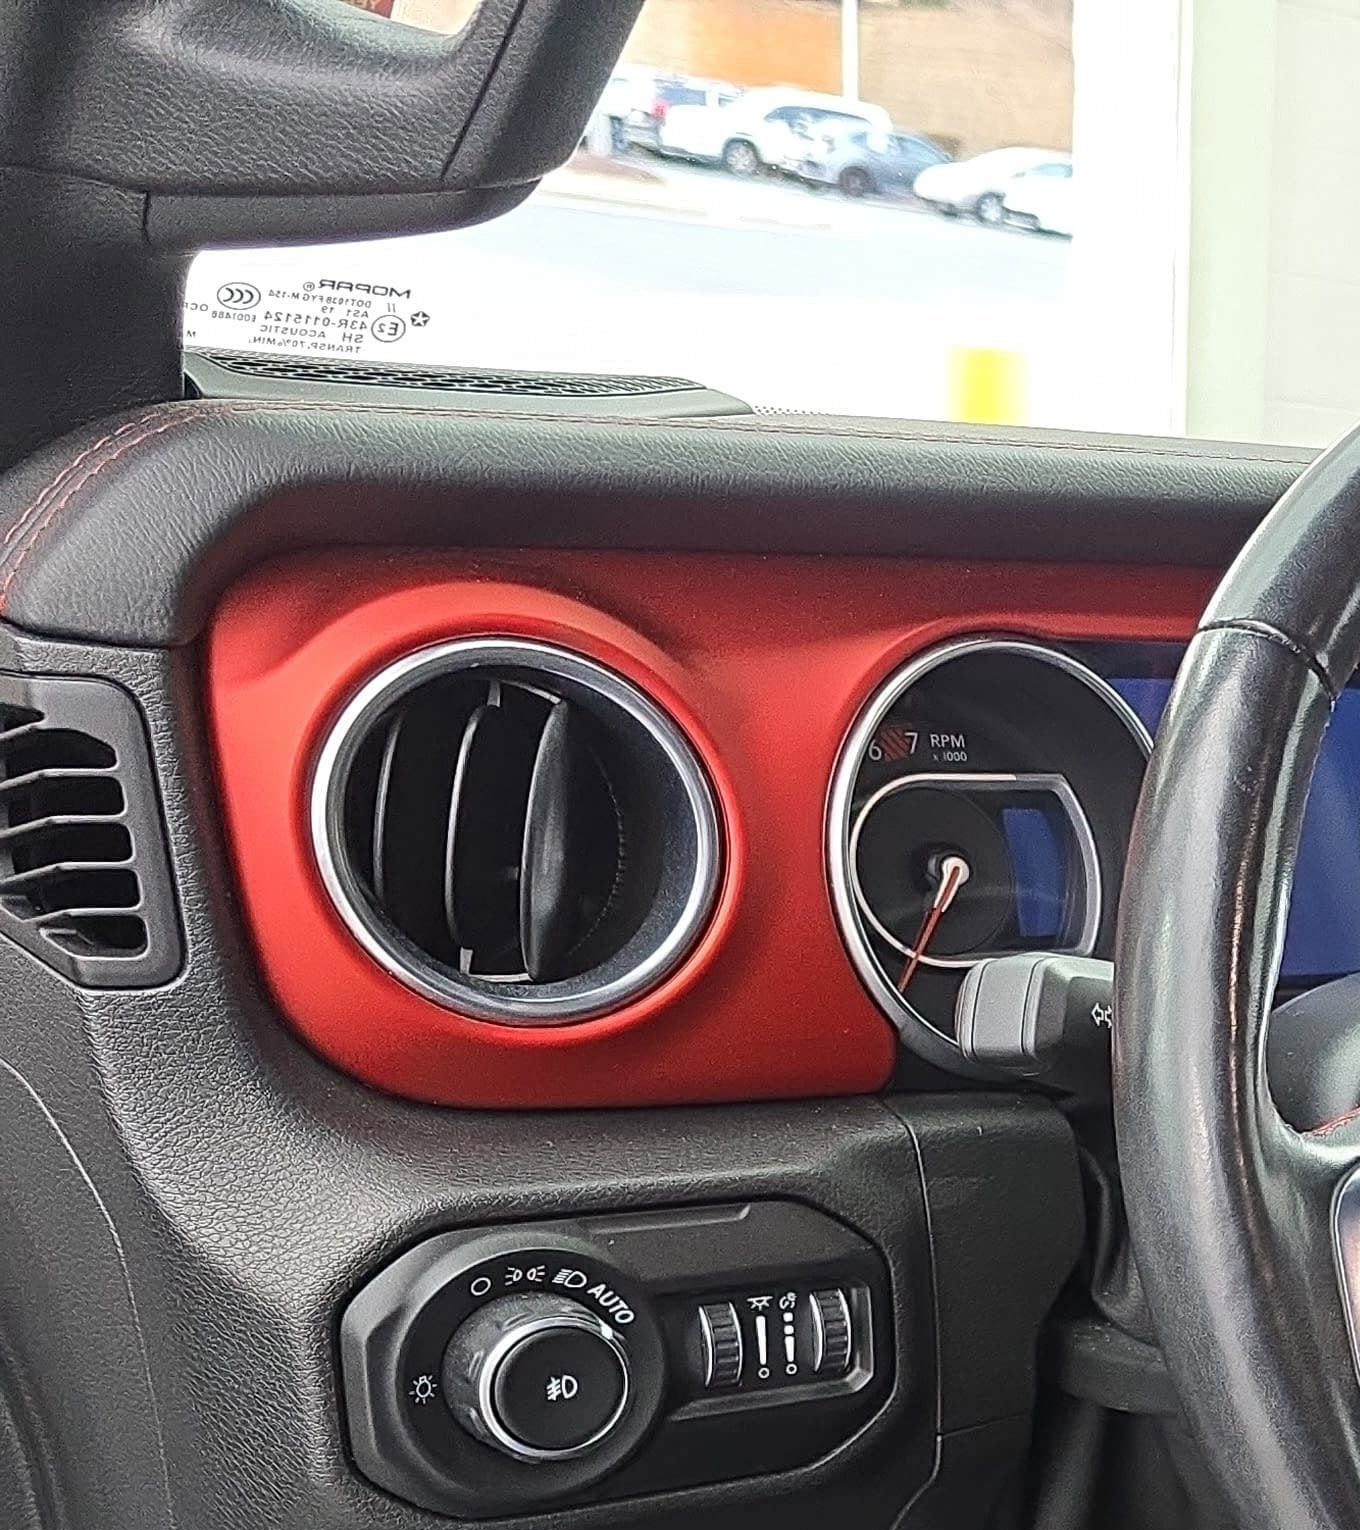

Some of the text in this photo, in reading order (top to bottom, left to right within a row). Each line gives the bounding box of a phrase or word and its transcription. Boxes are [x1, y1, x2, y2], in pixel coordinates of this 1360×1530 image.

[868, 739, 882, 761] 6
[904, 732, 918, 754] 7
[930, 734, 965, 749] RPM
[944, 752, 967, 762] 1000
[586, 1281, 637, 1327] AUTO
